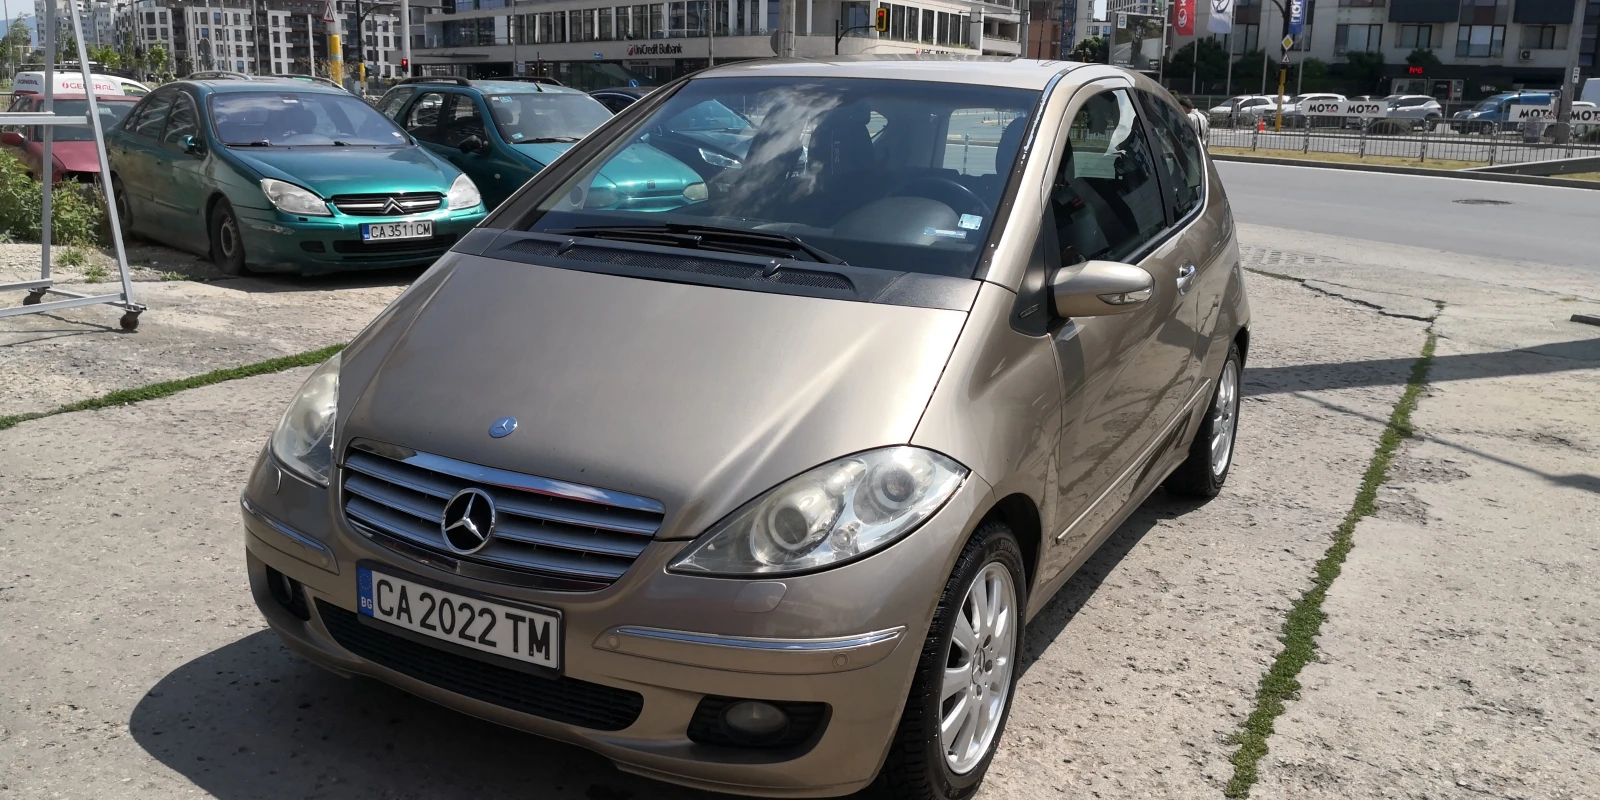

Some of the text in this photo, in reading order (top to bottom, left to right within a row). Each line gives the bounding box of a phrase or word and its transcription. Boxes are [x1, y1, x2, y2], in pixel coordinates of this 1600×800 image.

[633, 42, 683, 55] UniCredit Bulbank
[70, 82, 115, 91] GERAL
[1308, 103, 1339, 113] MOTO
[1346, 104, 1380, 114] MOTO
[371, 223, 431, 238] CA 3511 CM
[361, 596, 373, 610] BG
[376, 579, 551, 661] CA 2022 TM
